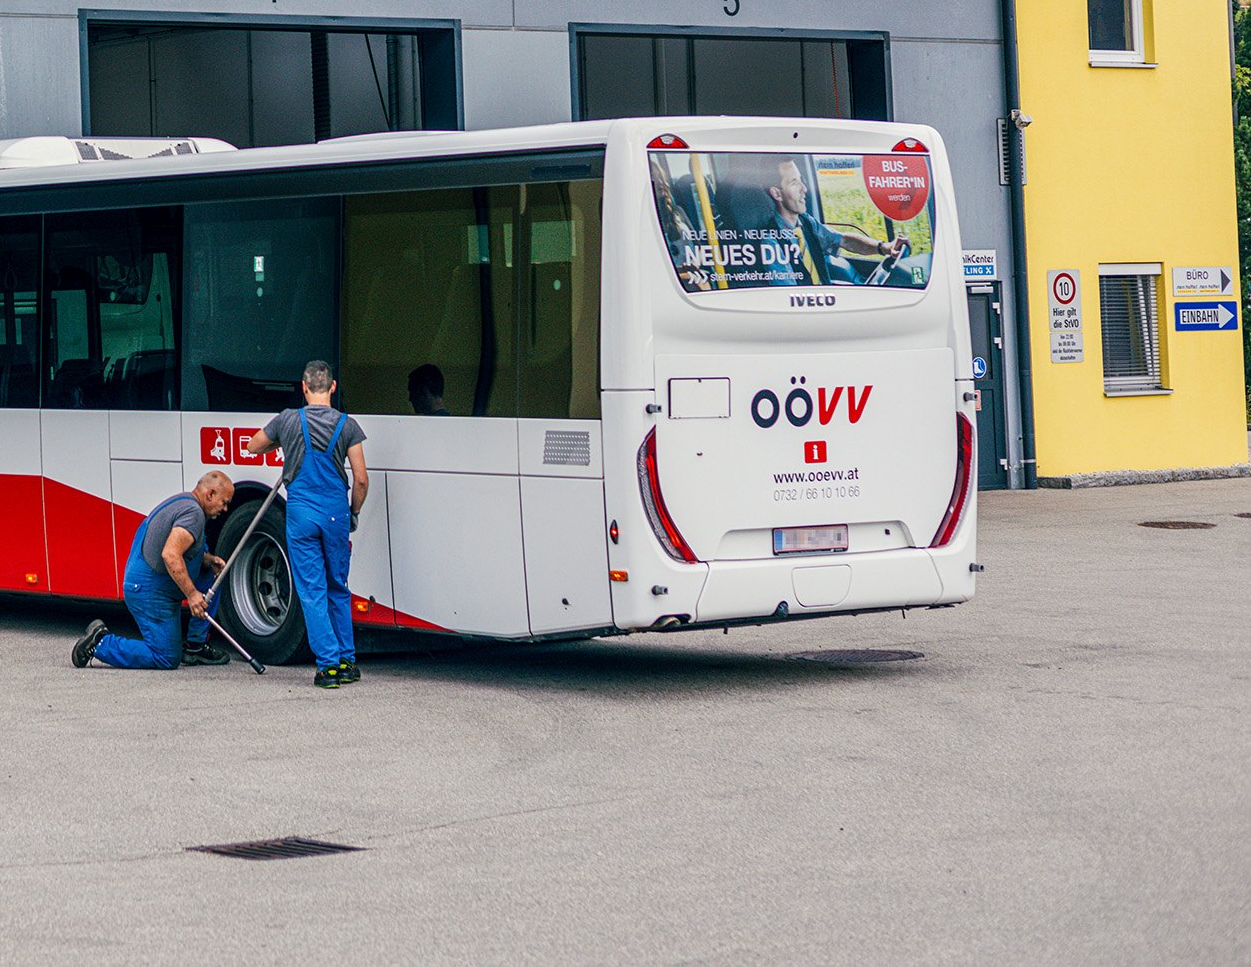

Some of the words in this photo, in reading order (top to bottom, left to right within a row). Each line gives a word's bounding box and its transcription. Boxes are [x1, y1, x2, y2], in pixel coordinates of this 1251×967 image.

[881, 160, 908, 173] BUS-
[682, 230, 707, 241] NEUE
[744, 229, 768, 240] NEUE
[759, 243, 800, 266] DU?
[1186, 269, 1209, 281] BÜRO
[1059, 281, 1070, 296] 10
[790, 294, 836, 308] IVECO
[1053, 307, 1065, 317] Hier
[1067, 307, 1077, 318] gilt
[1181, 310, 1219, 323] EINBAHN
[1053, 320, 1062, 329] die
[1064, 319, 1079, 329] StVO
[750, 375, 874, 429] OÖVV
[773, 467, 859, 484] www.ooevv.at
[773, 488, 797, 502] 0732
[806, 487, 818, 500] 66
[821, 486, 833, 499] 10
[835, 485, 847, 498] 10
[848, 485, 860, 497] 66
